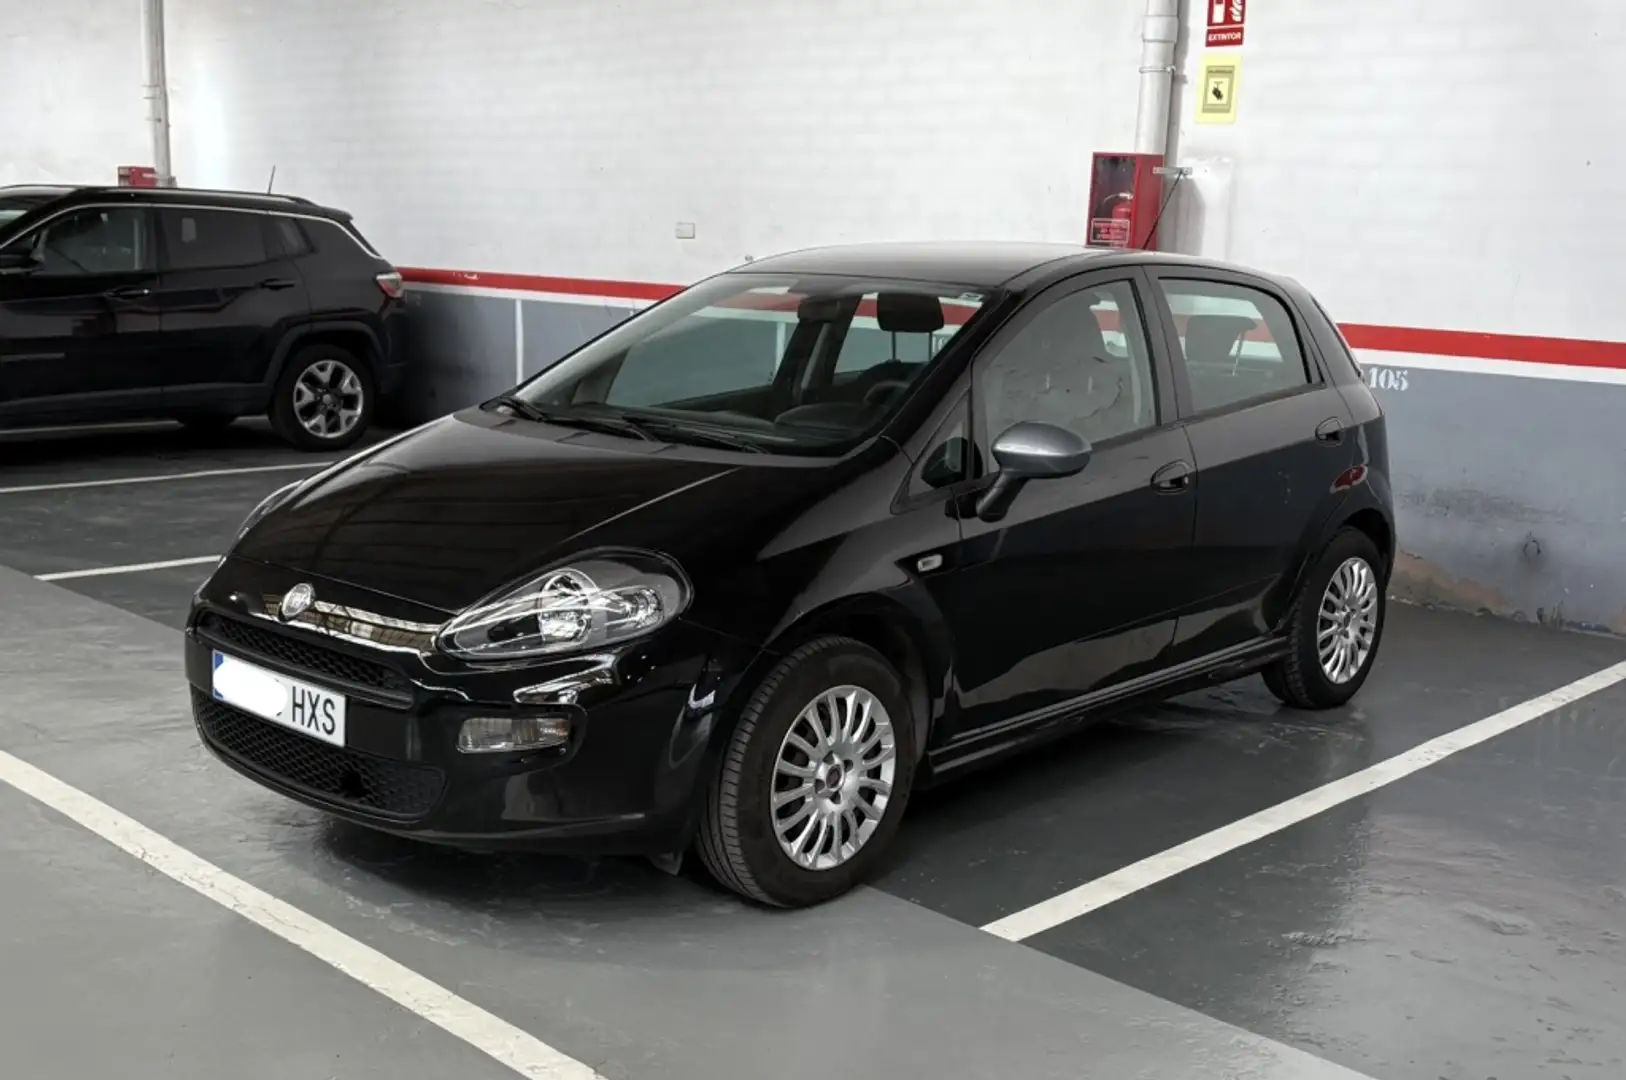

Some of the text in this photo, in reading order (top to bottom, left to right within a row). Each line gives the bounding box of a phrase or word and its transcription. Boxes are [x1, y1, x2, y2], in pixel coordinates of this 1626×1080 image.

[1208, 32, 1242, 41] EXTINTOR
[1369, 367, 1409, 391] 105
[292, 685, 336, 735] HXS
